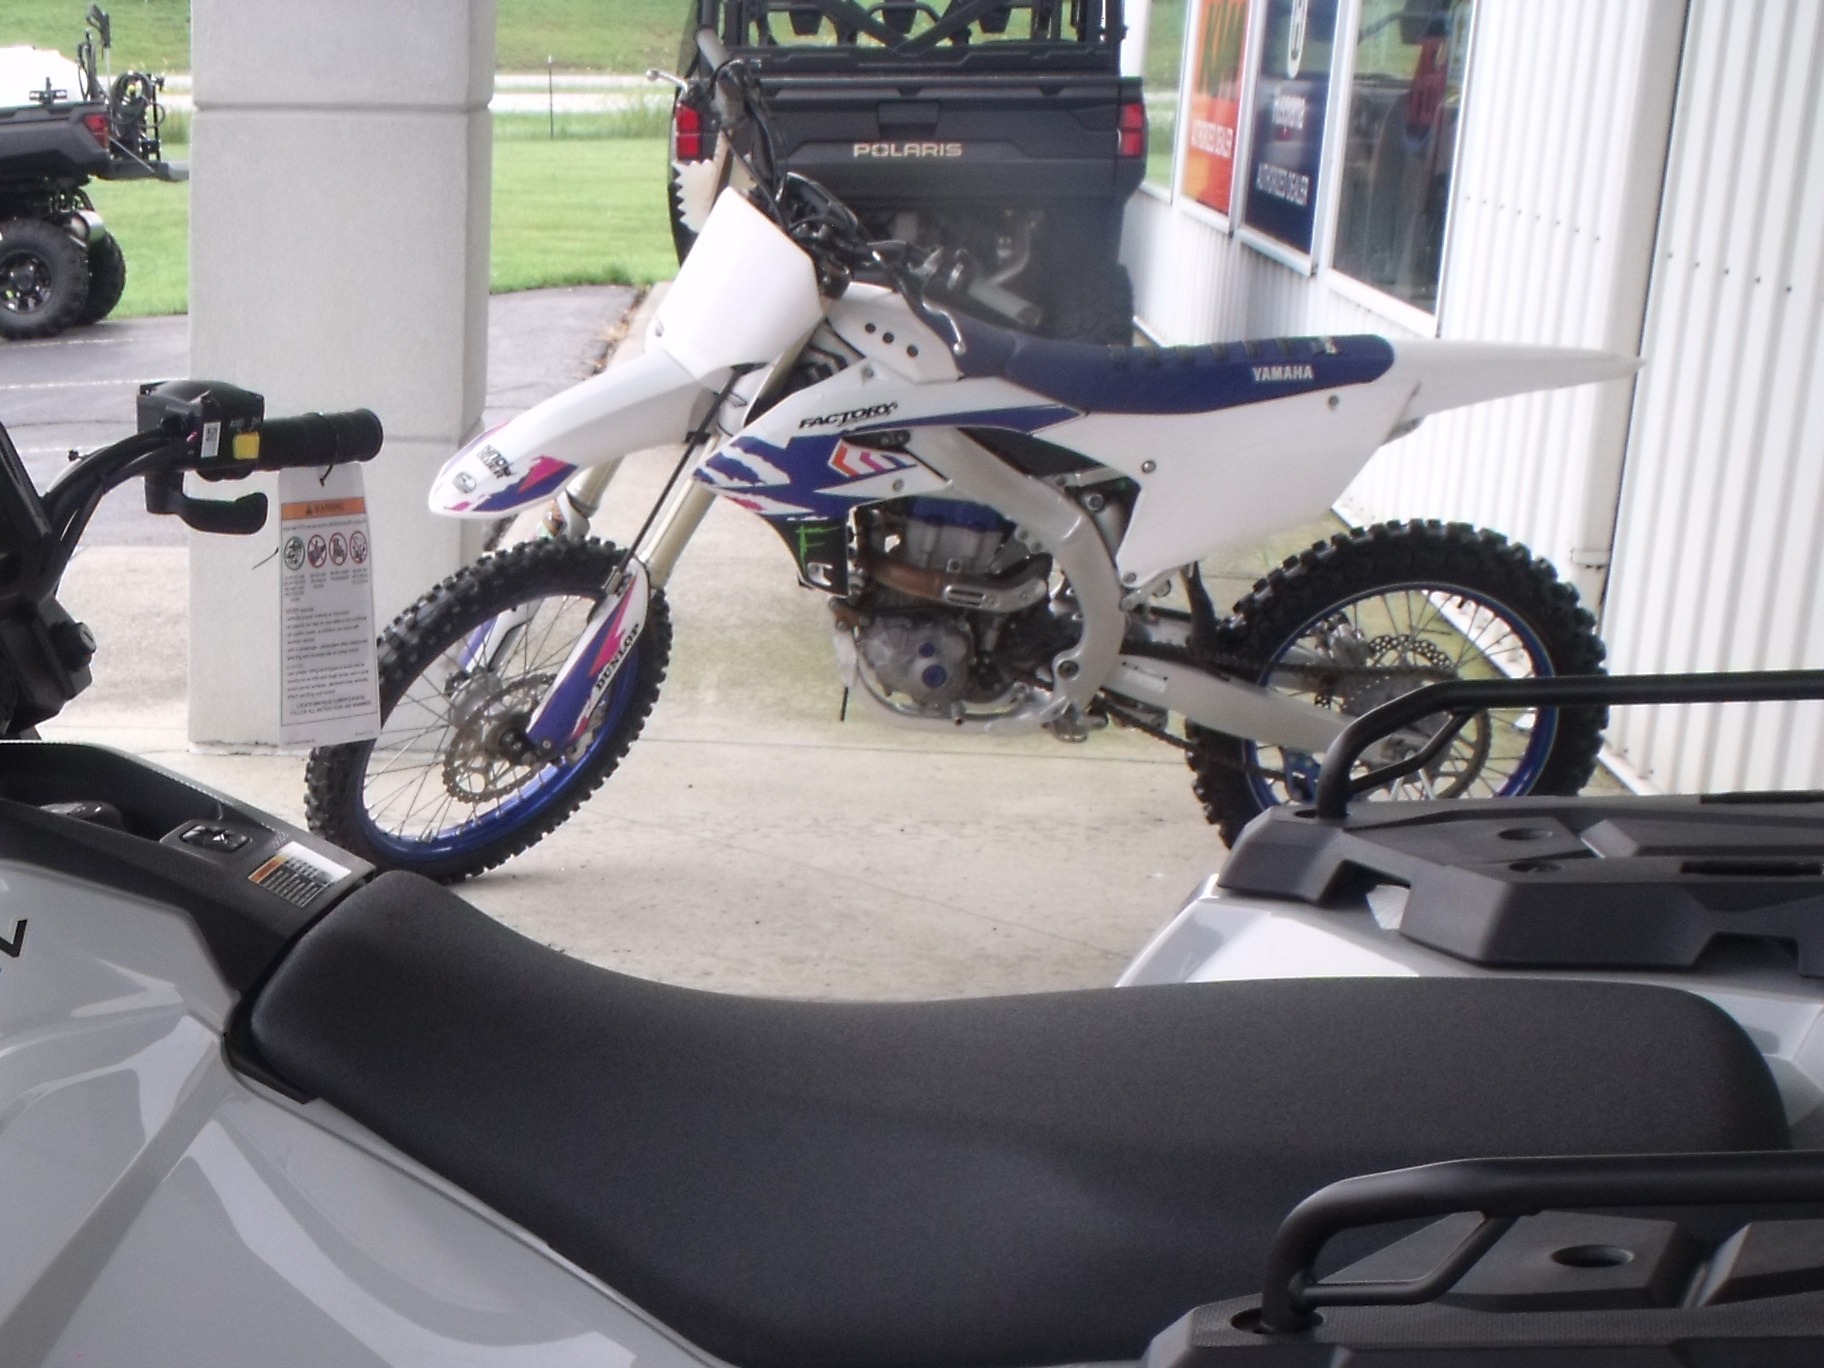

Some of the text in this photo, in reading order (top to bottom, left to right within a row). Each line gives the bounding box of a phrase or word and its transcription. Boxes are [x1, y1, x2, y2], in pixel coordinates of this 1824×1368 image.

[853, 142, 962, 158] POLARIS
[1252, 365, 1313, 381] YAMAHA
[798, 401, 898, 429] FACTORY
[596, 622, 639, 691] DUNLOP
